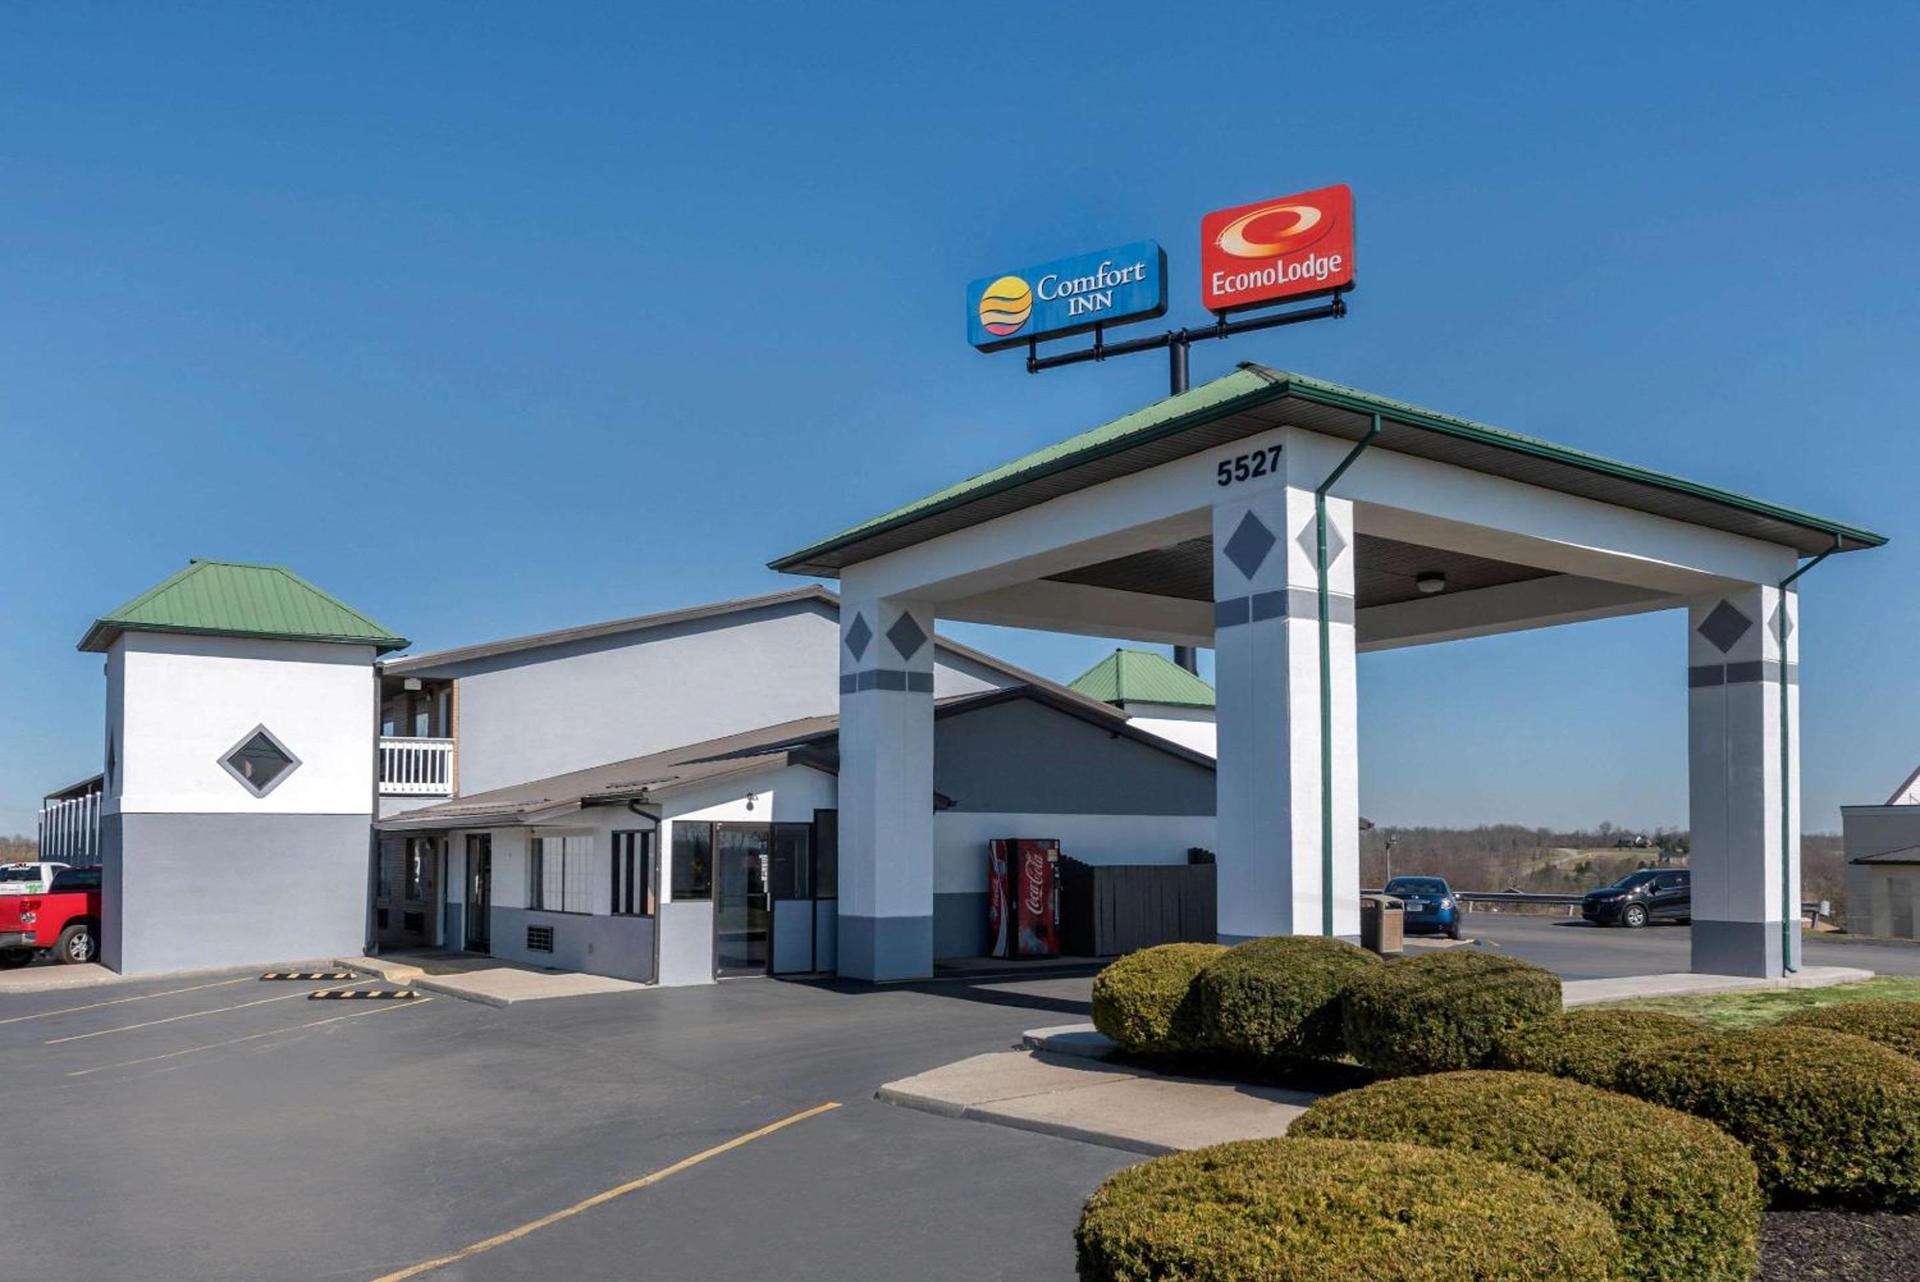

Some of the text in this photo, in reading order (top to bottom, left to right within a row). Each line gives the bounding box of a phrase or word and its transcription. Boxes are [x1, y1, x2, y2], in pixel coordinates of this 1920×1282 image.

[1037, 260, 1146, 301] Comfort
[1212, 253, 1342, 296] EconoLodge
[1068, 290, 1113, 316] INN
[1217, 444, 1283, 487] 5527
